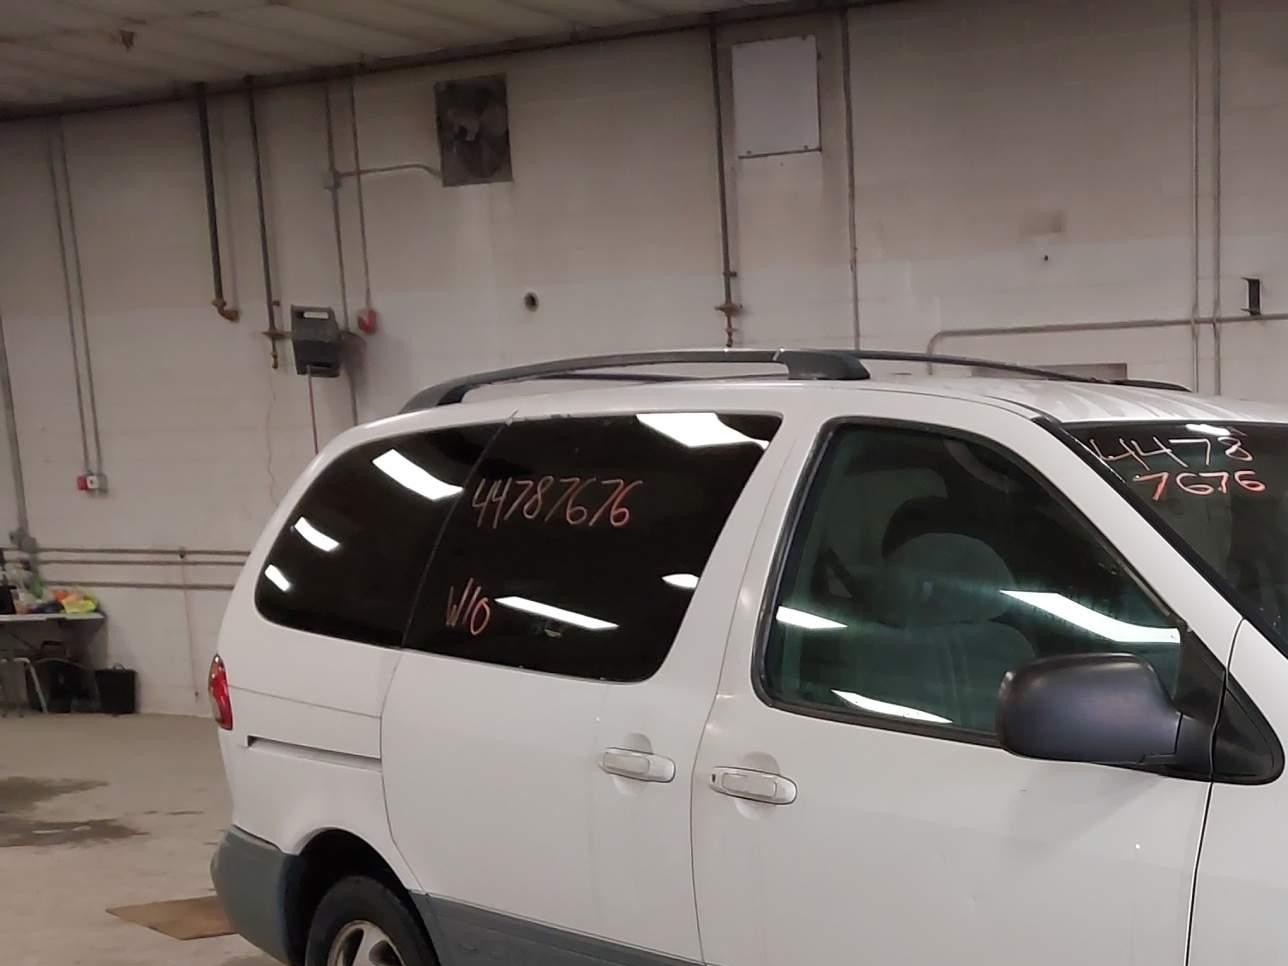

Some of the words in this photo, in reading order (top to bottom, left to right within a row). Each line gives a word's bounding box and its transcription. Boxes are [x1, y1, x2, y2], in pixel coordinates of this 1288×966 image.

[1089, 436, 1253, 471] 4478
[472, 475, 643, 529] 44787676
[1133, 471, 1266, 500] 7676
